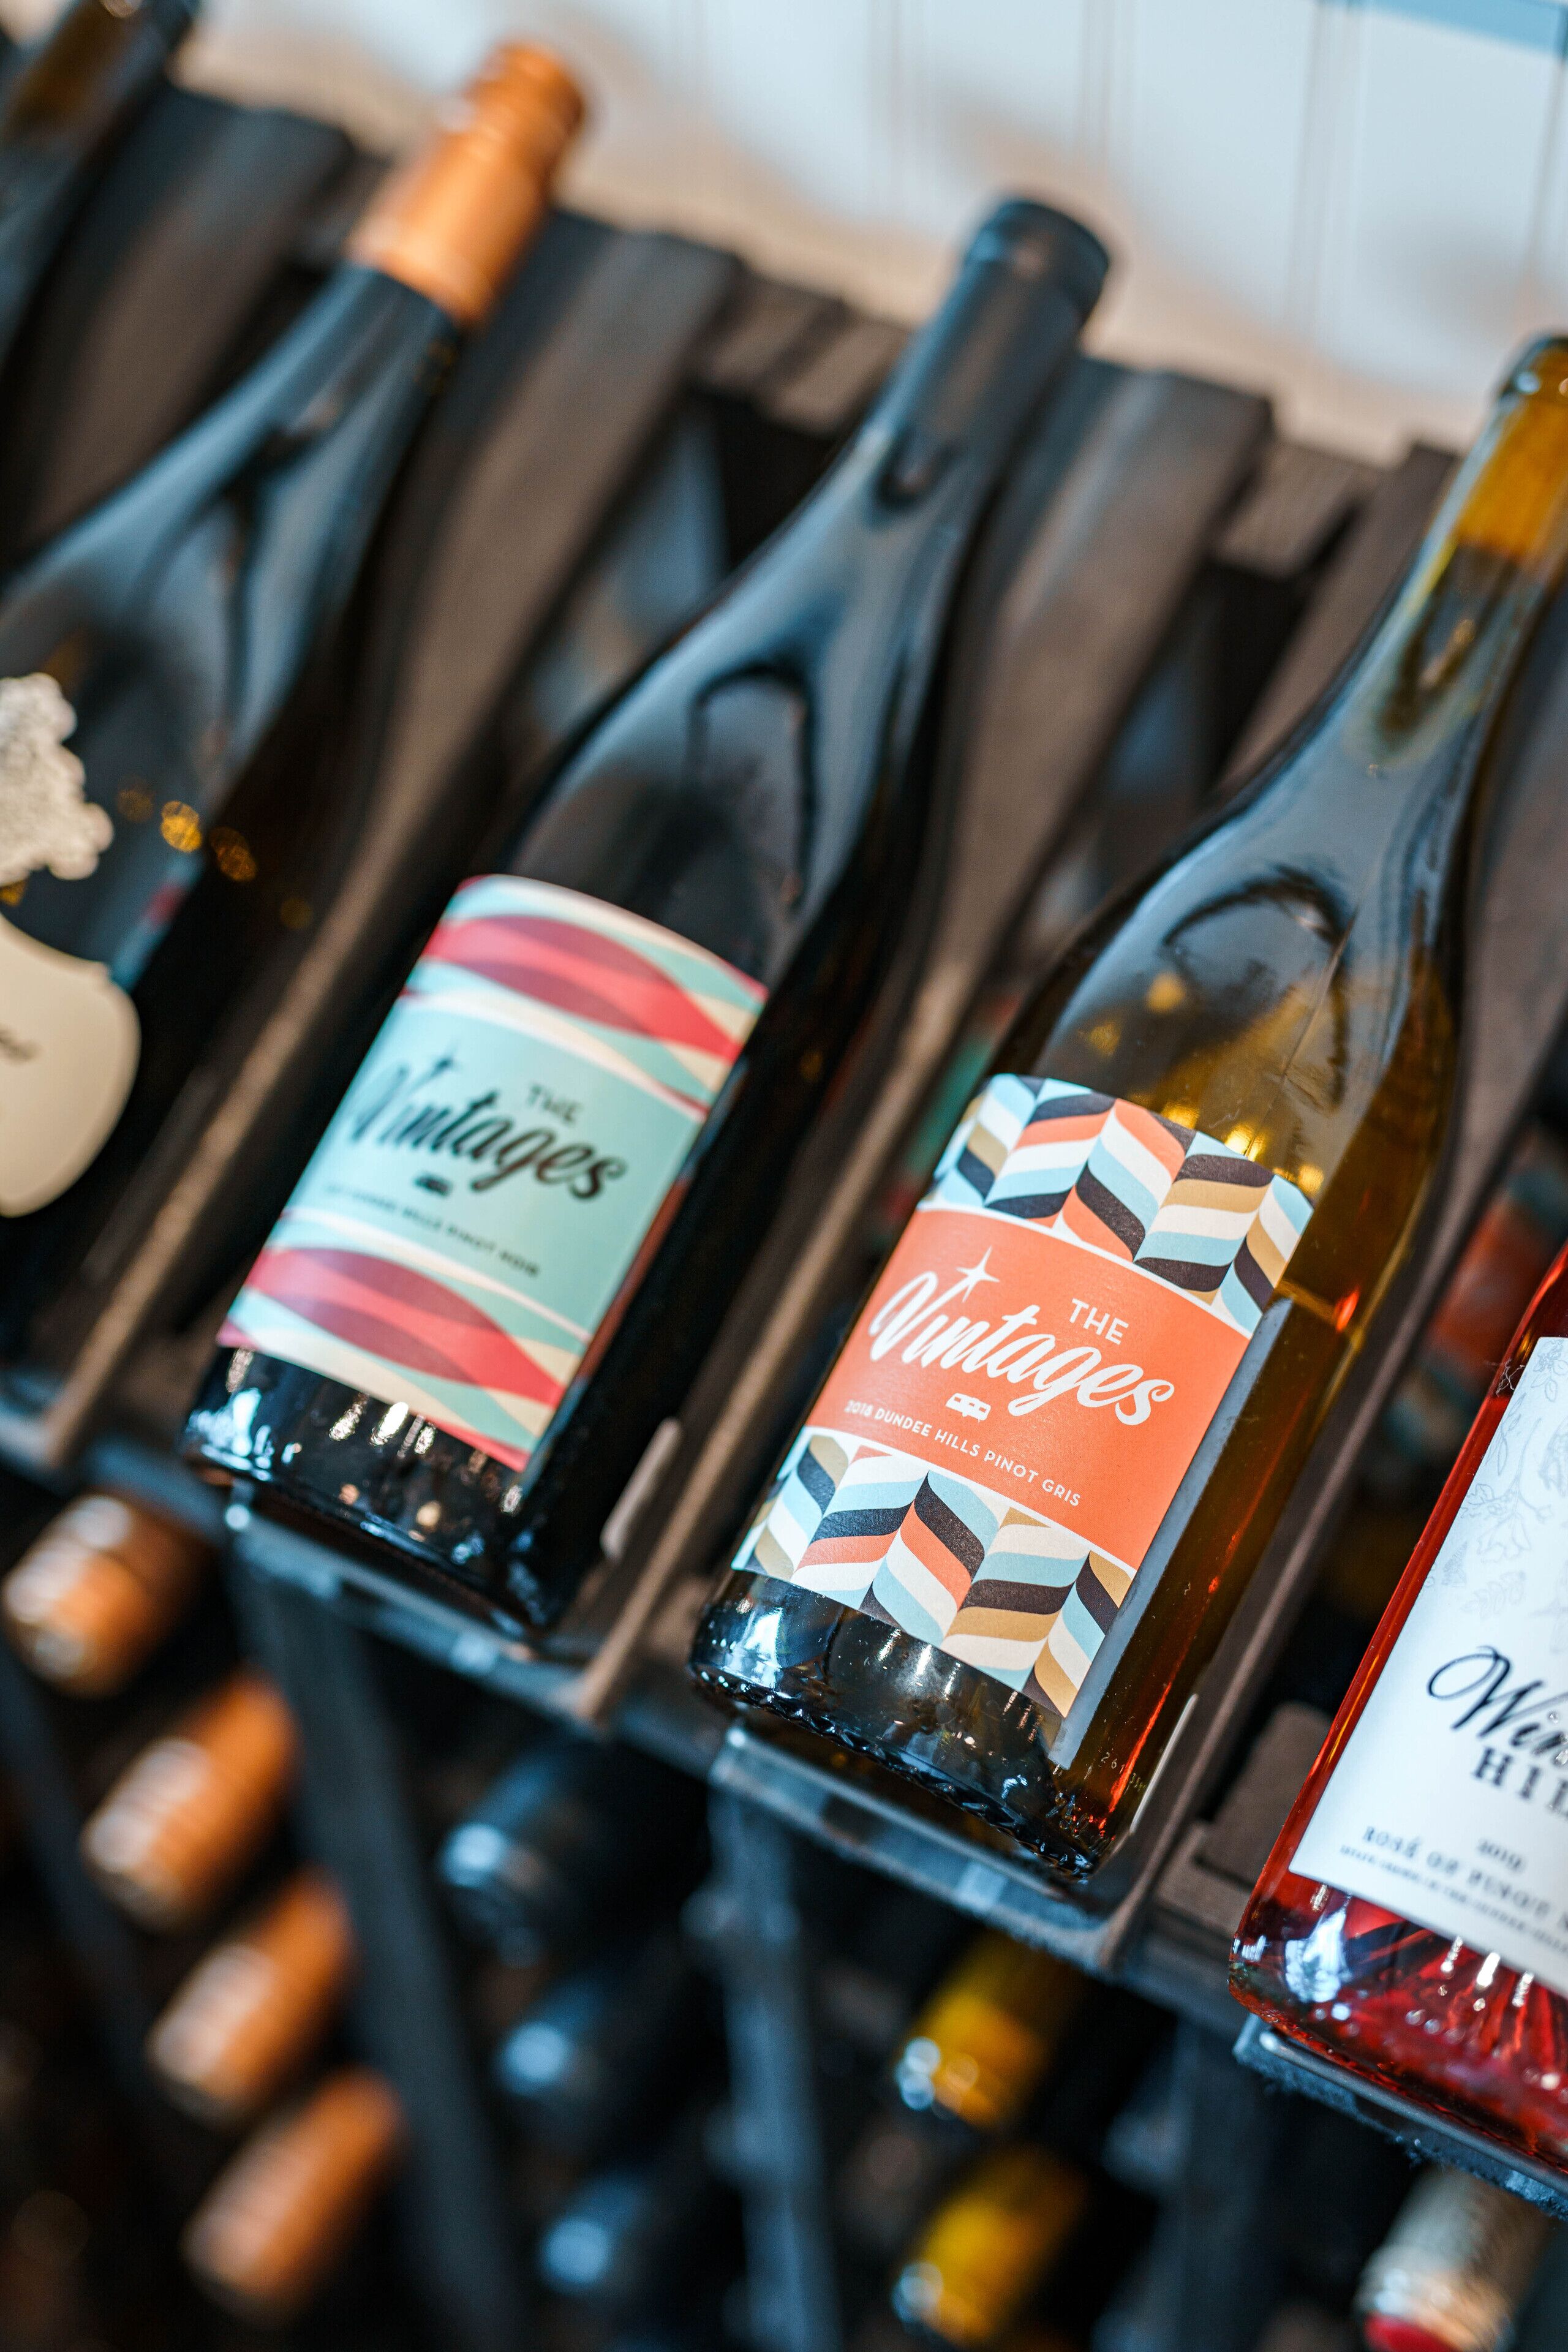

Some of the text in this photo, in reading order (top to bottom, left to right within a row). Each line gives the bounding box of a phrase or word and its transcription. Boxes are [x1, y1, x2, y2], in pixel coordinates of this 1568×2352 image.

[349, 1041, 627, 1200] Vintages
[527, 1082, 586, 1127] THE
[869, 1246, 1175, 1426] Vintages
[1068, 1298, 1129, 1345] THE
[845, 1400, 1082, 1507] 2018 DUNDEE HILLS PINOT GRIS
